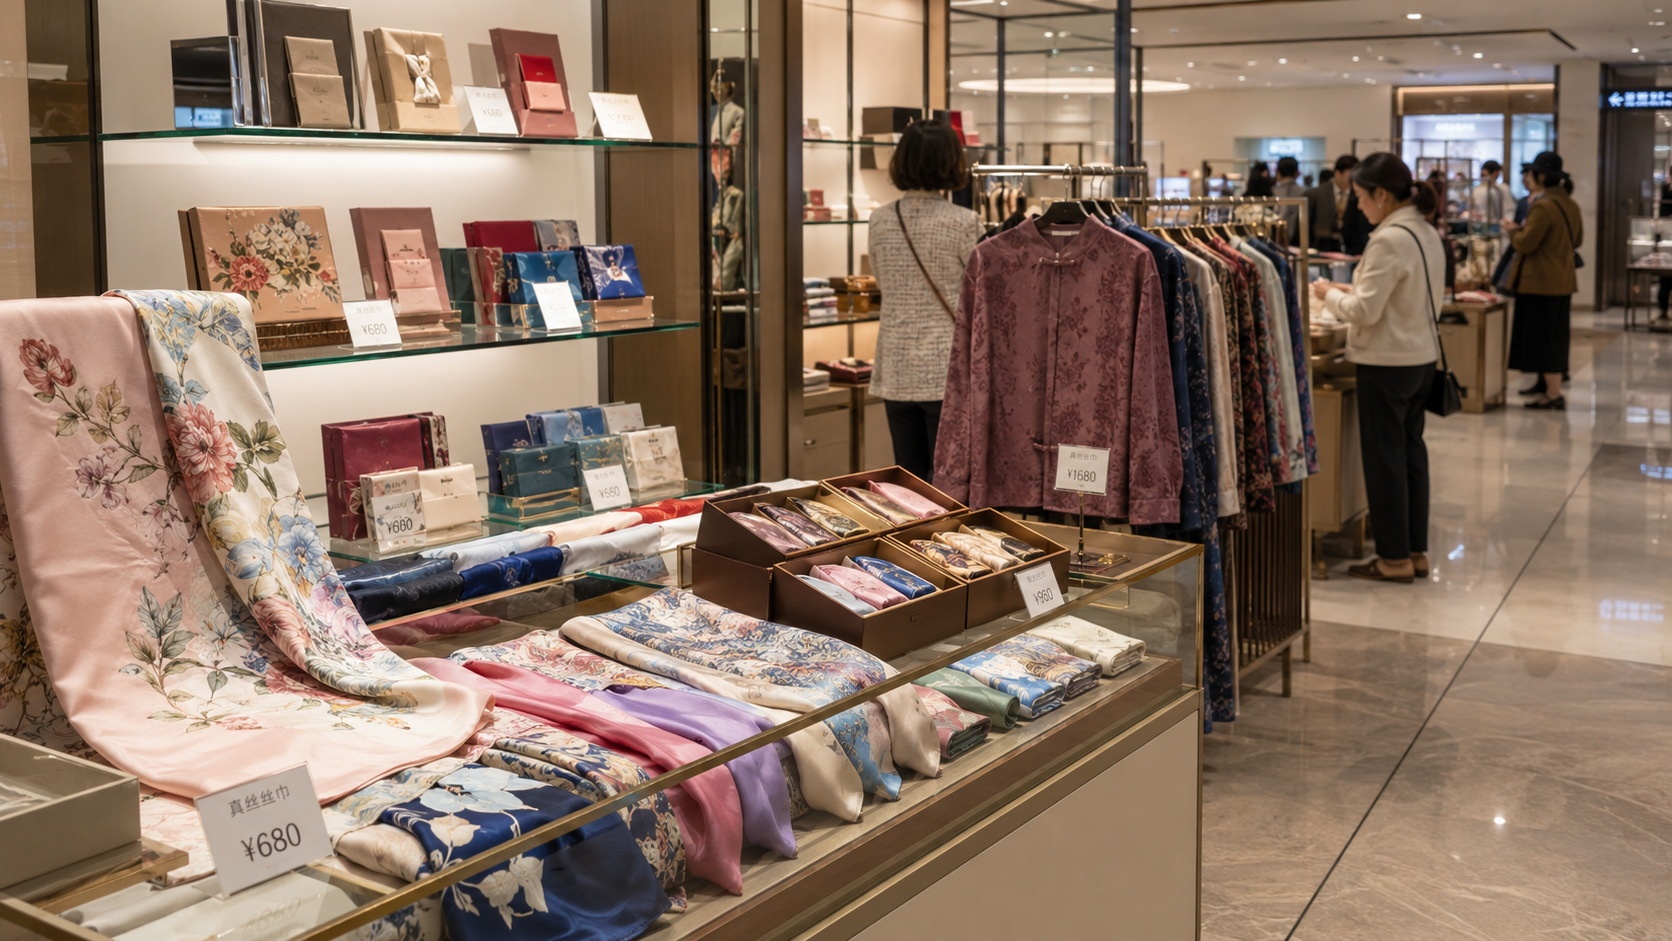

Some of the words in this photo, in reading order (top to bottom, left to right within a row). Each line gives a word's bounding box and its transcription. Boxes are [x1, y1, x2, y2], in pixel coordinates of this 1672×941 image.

[361, 322, 387, 336] ¥680
[1067, 468, 1097, 483] ¥1680
[228, 784, 290, 818] 真丝丝巾
[240, 822, 301, 862] ¥680
